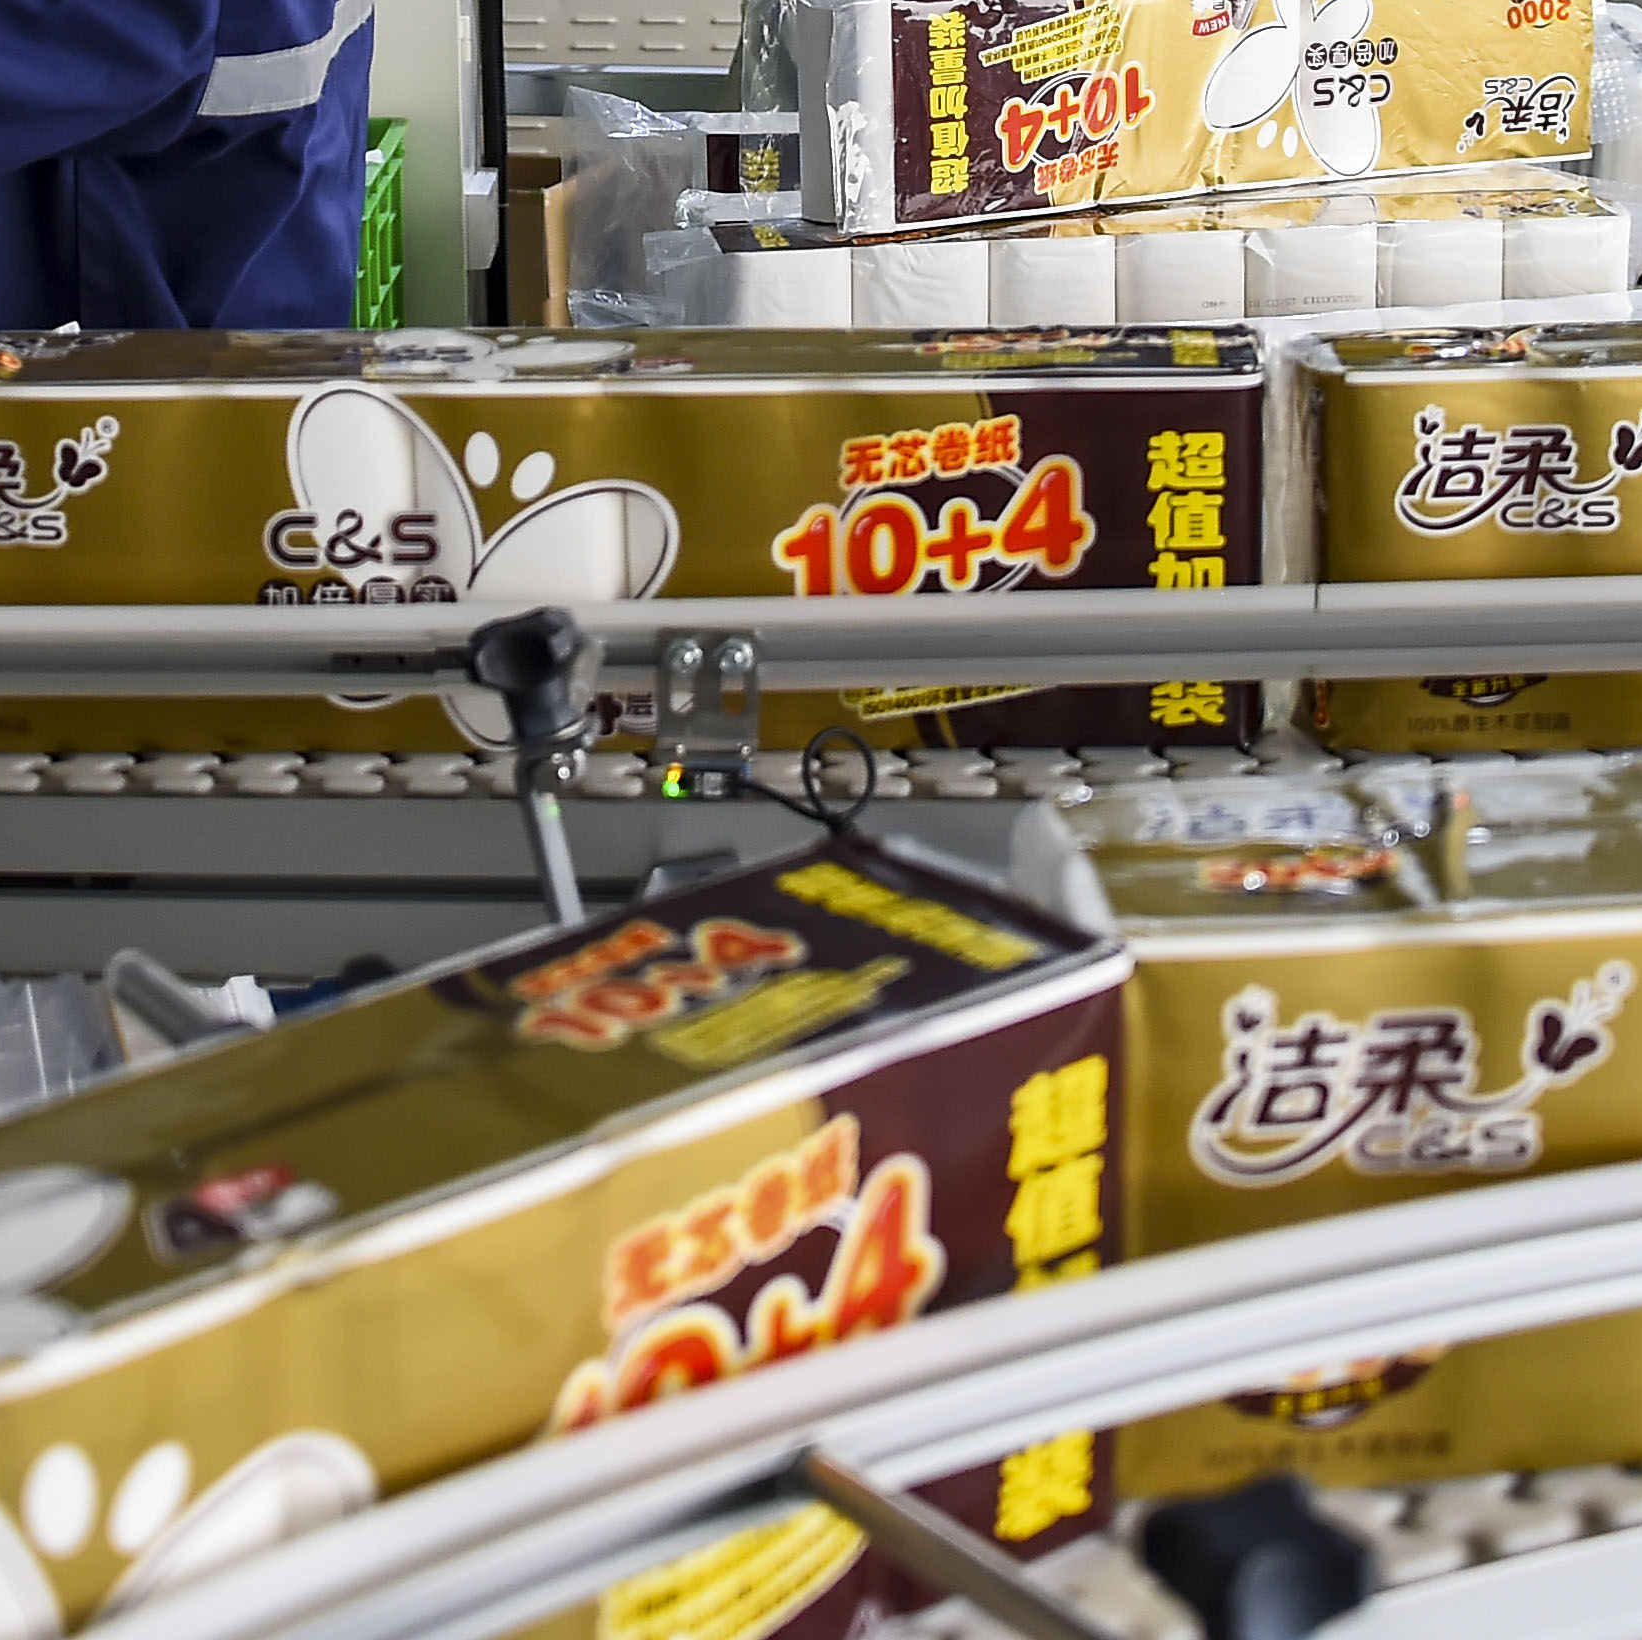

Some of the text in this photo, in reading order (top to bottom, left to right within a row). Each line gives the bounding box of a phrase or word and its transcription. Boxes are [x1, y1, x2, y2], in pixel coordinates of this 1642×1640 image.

[1194, 14, 1229, 34] NEW
[1302, 37, 1399, 71] 加倍厚实
[928, 11, 970, 196] 超值加量装
[997, 62, 1154, 171] 10+4
[1310, 73, 1392, 109] C&S
[1483, 76, 1535, 95] C&S
[1484, 75, 1577, 138] 洁柔
[1036, 141, 1119, 191] 无芯卷纸
[841, 416, 1020, 490] 无芯卷纸
[1397, 420, 1575, 534] 洁柔
[267, 509, 440, 568] C&S
[777, 461, 1093, 596] 10+4
[1497, 497, 1617, 529] C&S
[1146, 430, 1227, 727] 超值加装
[1197, 998, 1473, 1182] 洁柔
